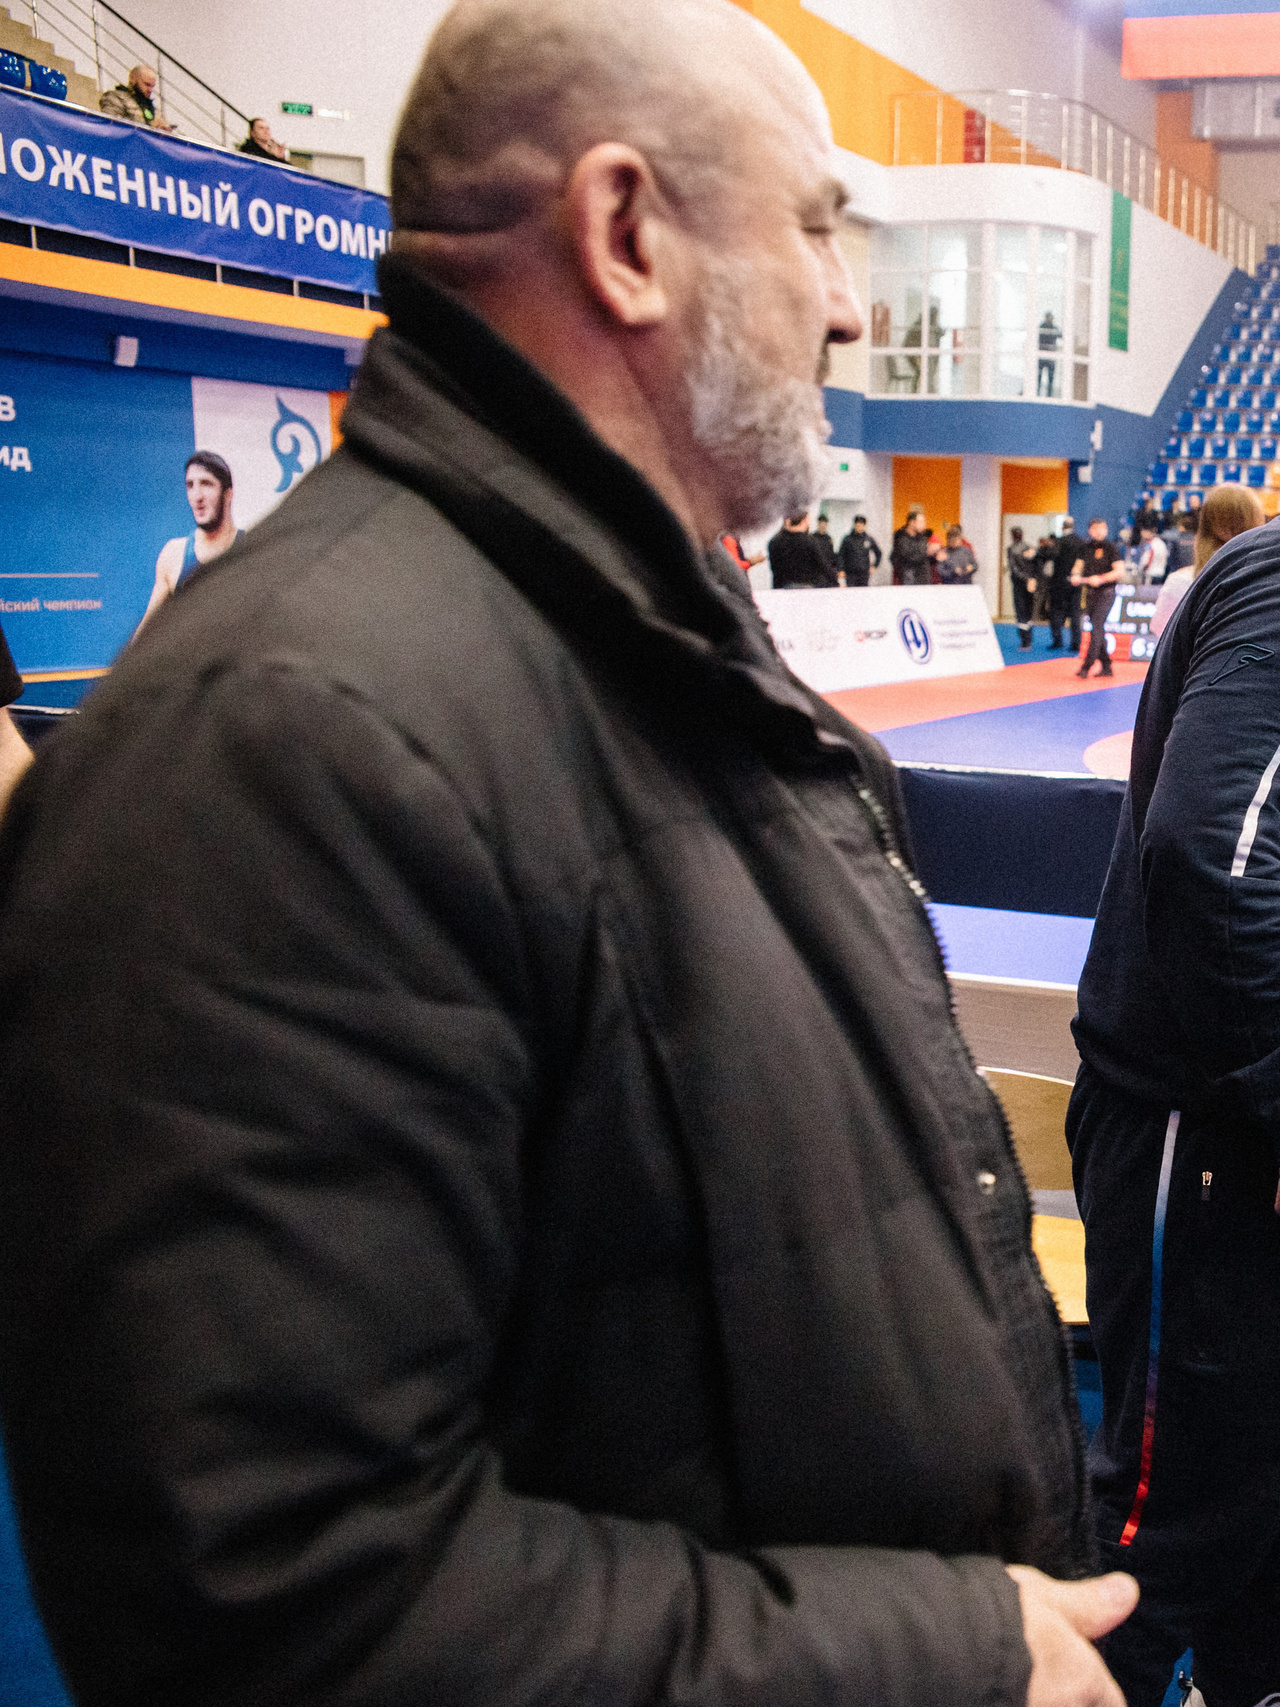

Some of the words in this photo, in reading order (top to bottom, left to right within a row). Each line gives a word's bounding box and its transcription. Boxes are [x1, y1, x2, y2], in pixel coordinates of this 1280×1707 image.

[0, 131, 240, 230] ОЖЕННЫЙ
[248, 198, 393, 261] ОГРОМН
[43, 599, 102, 611] чемпион
